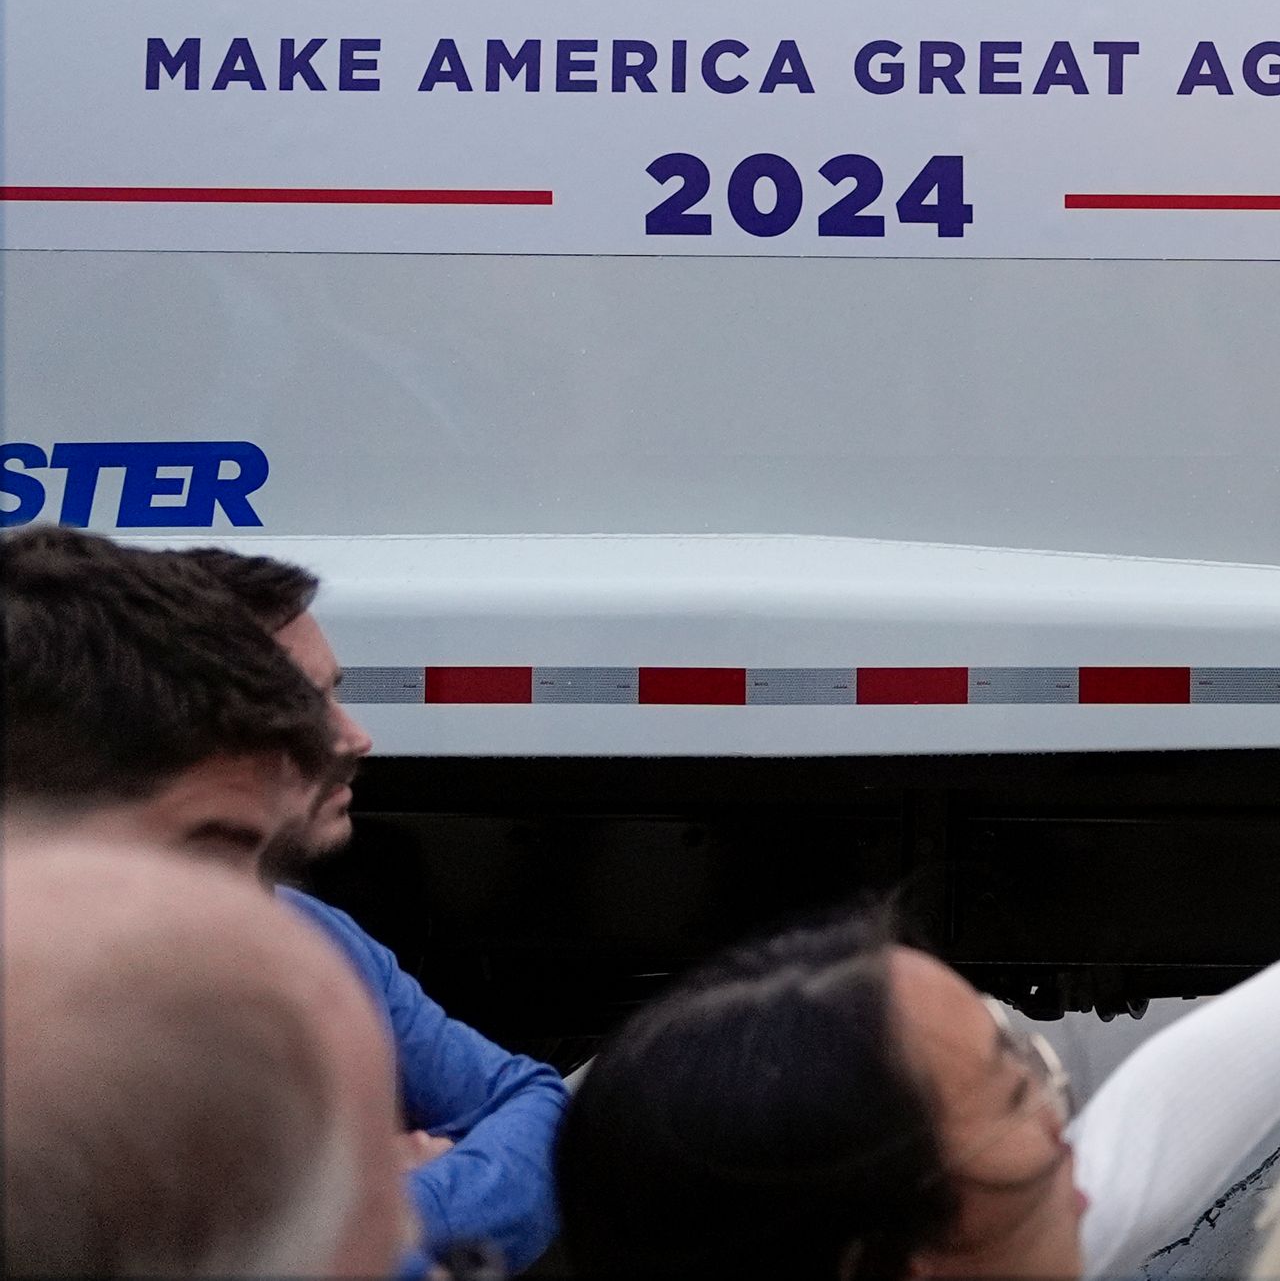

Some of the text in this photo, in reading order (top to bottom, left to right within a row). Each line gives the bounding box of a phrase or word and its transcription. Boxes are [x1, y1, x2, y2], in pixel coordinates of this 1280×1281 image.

[146, 37, 382, 92] MAKE
[418, 38, 816, 95] AMERICA
[853, 39, 1140, 96] GREAT
[646, 152, 974, 238] 2024
